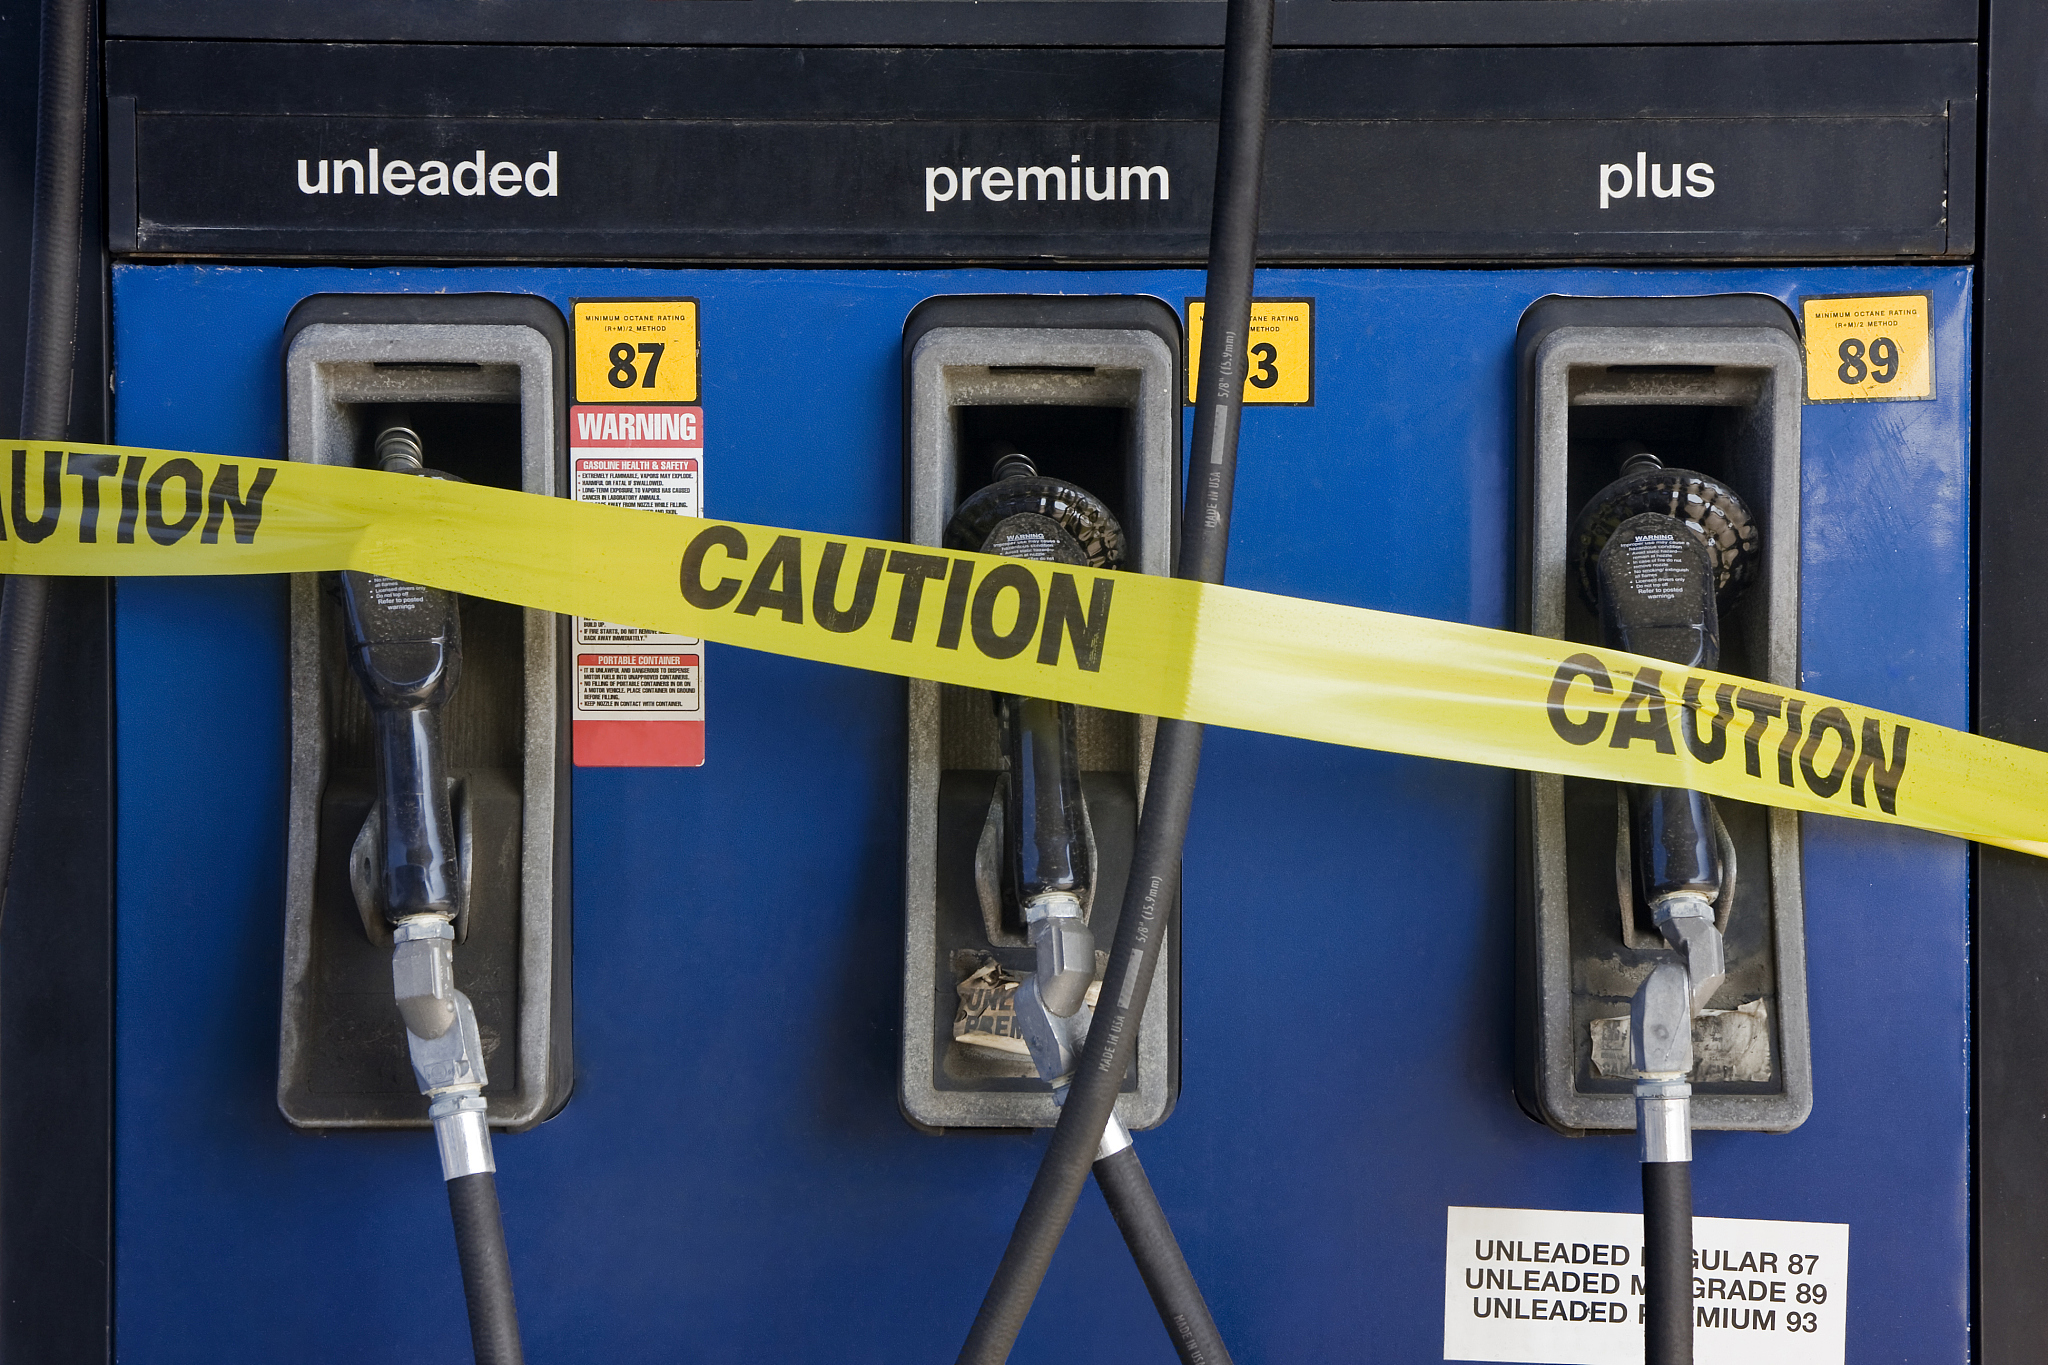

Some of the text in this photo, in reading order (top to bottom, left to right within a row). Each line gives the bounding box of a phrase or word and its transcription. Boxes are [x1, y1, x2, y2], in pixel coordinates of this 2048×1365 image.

[298, 149, 557, 196] unleaded
[926, 155, 1169, 211] premium
[1600, 152, 1714, 208] plus
[608, 342, 665, 389] 87
[1249, 342, 1279, 389] 3
[1838, 337, 1899, 385] 89
[577, 413, 696, 440] WARNING
[583, 461, 689, 470] GASOLINE HEALTH & SAFETY
[1209, 472, 1221, 488] USA
[0, 450, 277, 546] UTION
[1207, 491, 1219, 501] IN
[1205, 503, 1217, 528] MADE
[1635, 534, 1674, 542] WARNING
[680, 525, 1115, 673] CAUTION
[598, 656, 681, 665] PORTABLE CONTAINER
[1547, 652, 1911, 816] CAUTION
[1098, 875, 1163, 1072] MADE IN USA 5/8" (15.9mm)
[1475, 1239, 1630, 1266] UNLEADED
[1787, 1253, 1820, 1275] 87
[1465, 1267, 1620, 1295] UNLEADED
[1795, 1283, 1828, 1305] 89
[1173, 1314, 1193, 1340] MADE
[1185, 1339, 1198, 1351] IN
[1473, 1297, 1628, 1324] UNLEADED
[1786, 1311, 1818, 1333] 93
